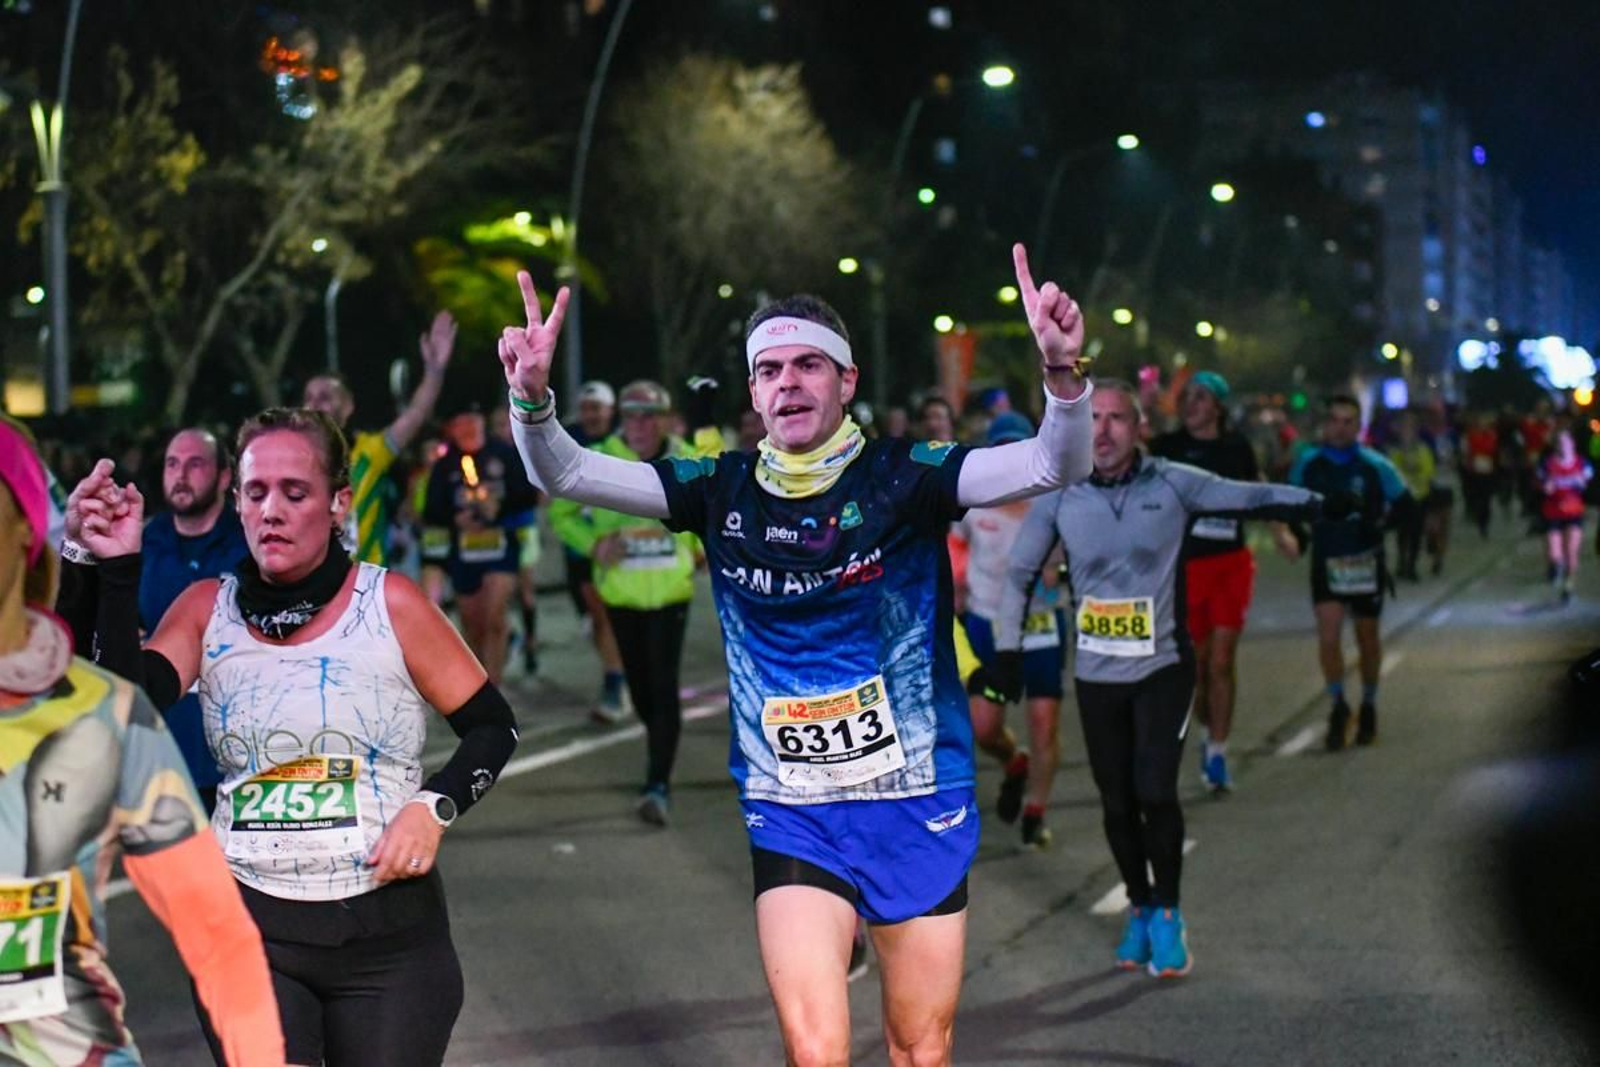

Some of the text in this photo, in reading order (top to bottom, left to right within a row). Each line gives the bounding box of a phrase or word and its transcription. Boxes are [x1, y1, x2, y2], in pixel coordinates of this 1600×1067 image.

[1082, 612, 1145, 637] 3858
[787, 702, 810, 719] 42
[777, 709, 883, 754] 6313
[239, 781, 346, 820] 2452
